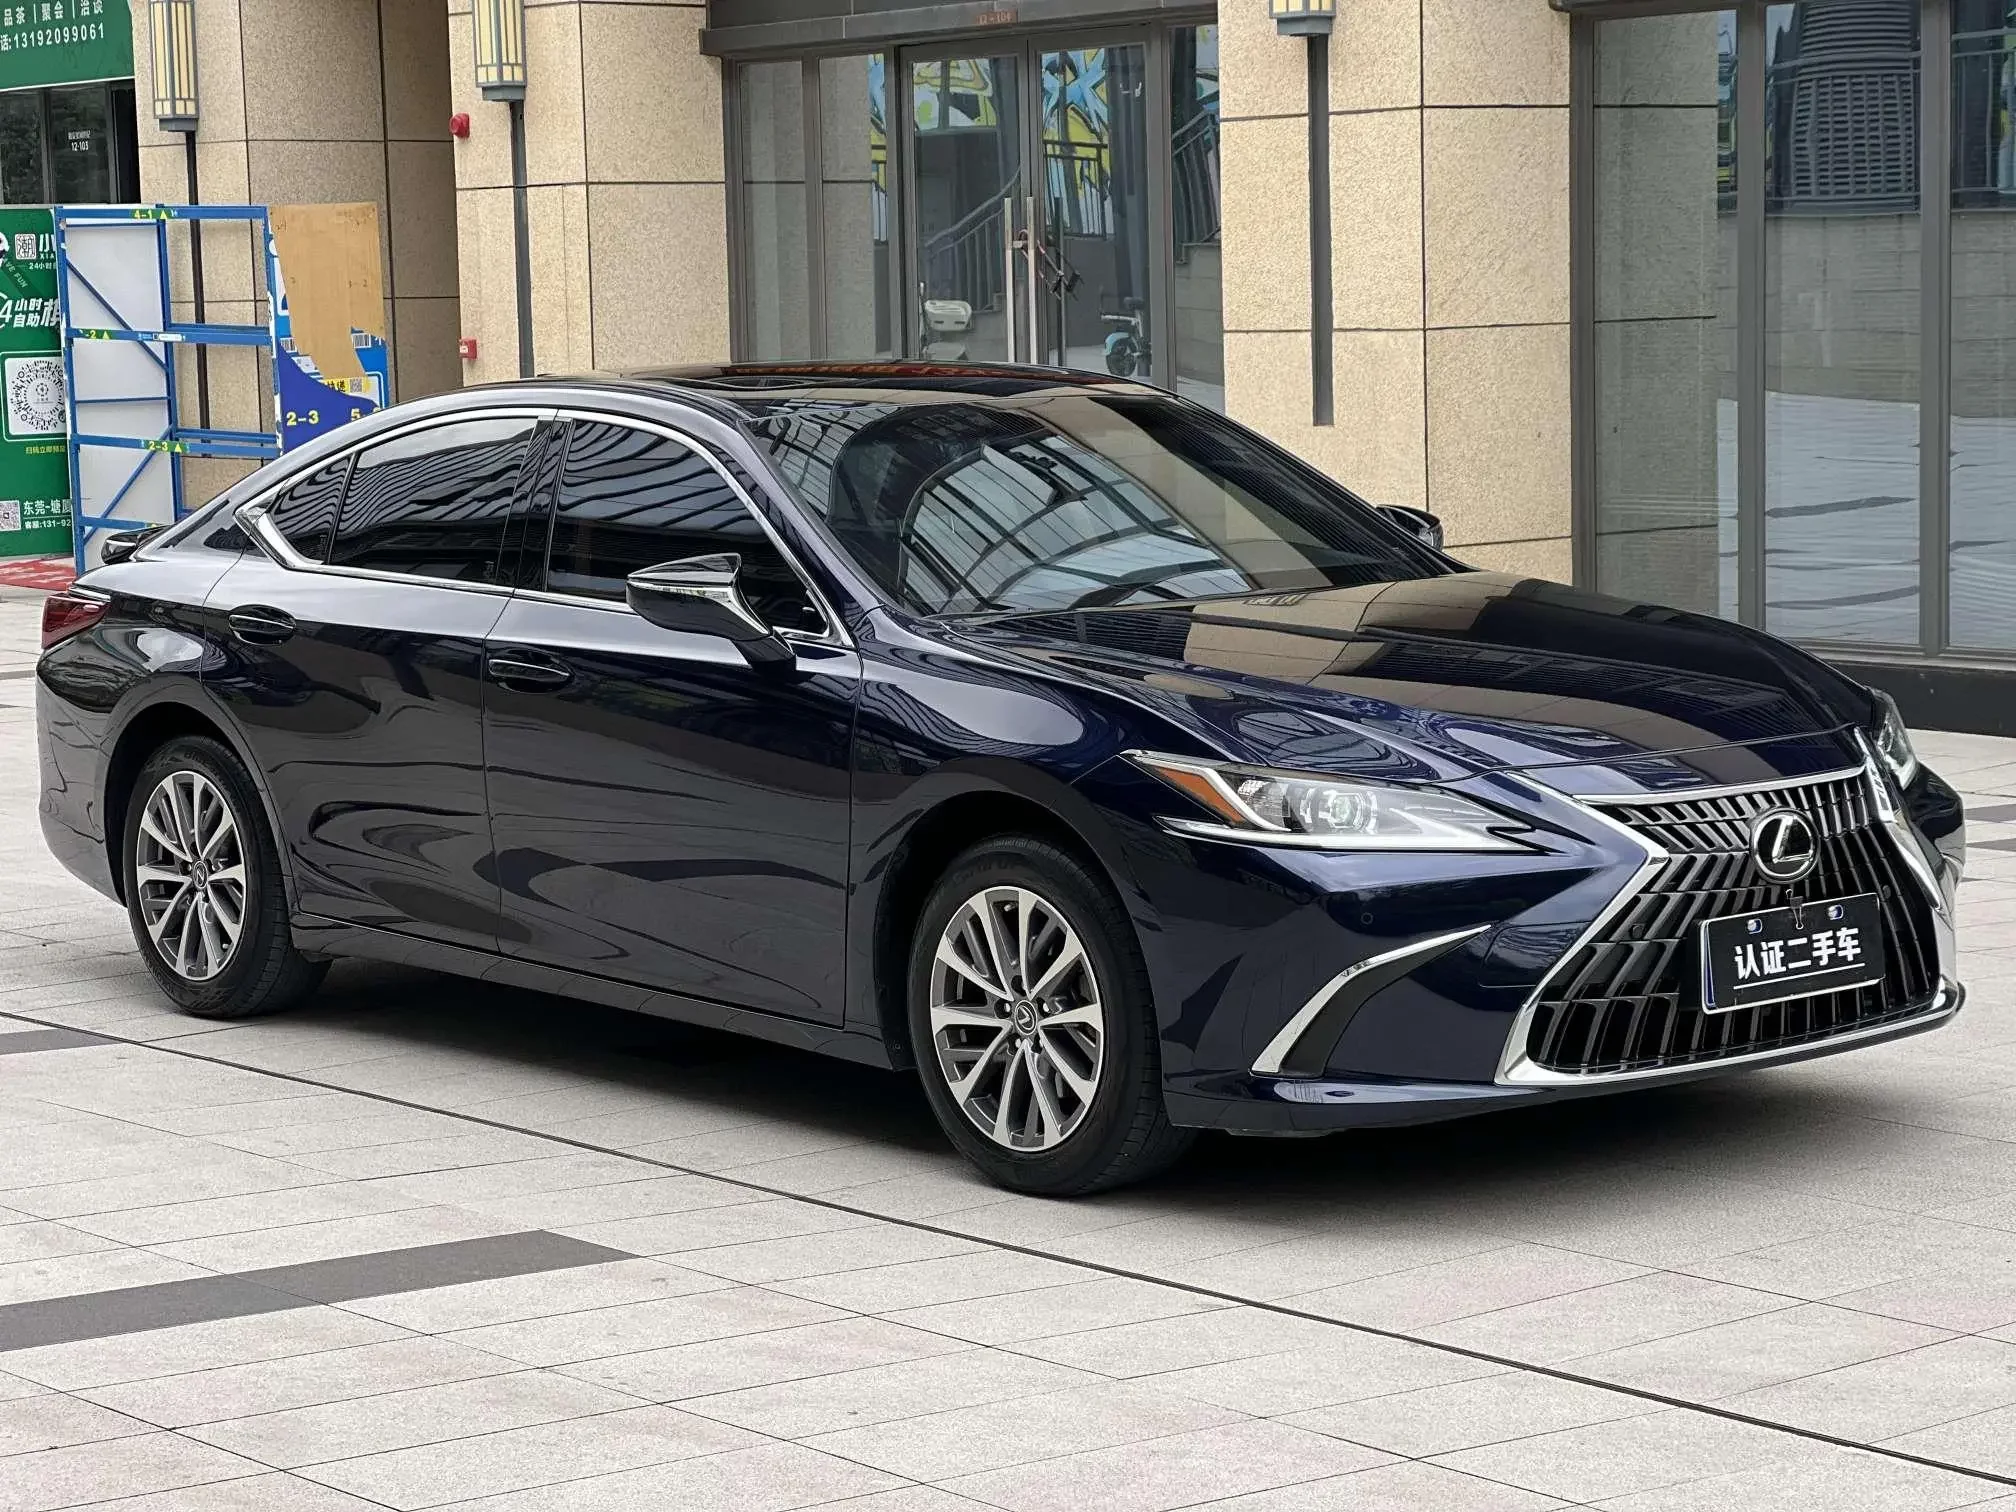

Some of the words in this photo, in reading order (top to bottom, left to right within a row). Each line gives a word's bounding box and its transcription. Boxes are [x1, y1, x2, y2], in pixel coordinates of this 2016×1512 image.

[4, 6, 26, 27] 品茶
[41, 0, 64, 22] 聚会
[286, 410, 320, 427] 2-3
[149, 440, 168, 451] 2-3
[1734, 926, 1861, 980] 认证二手车
